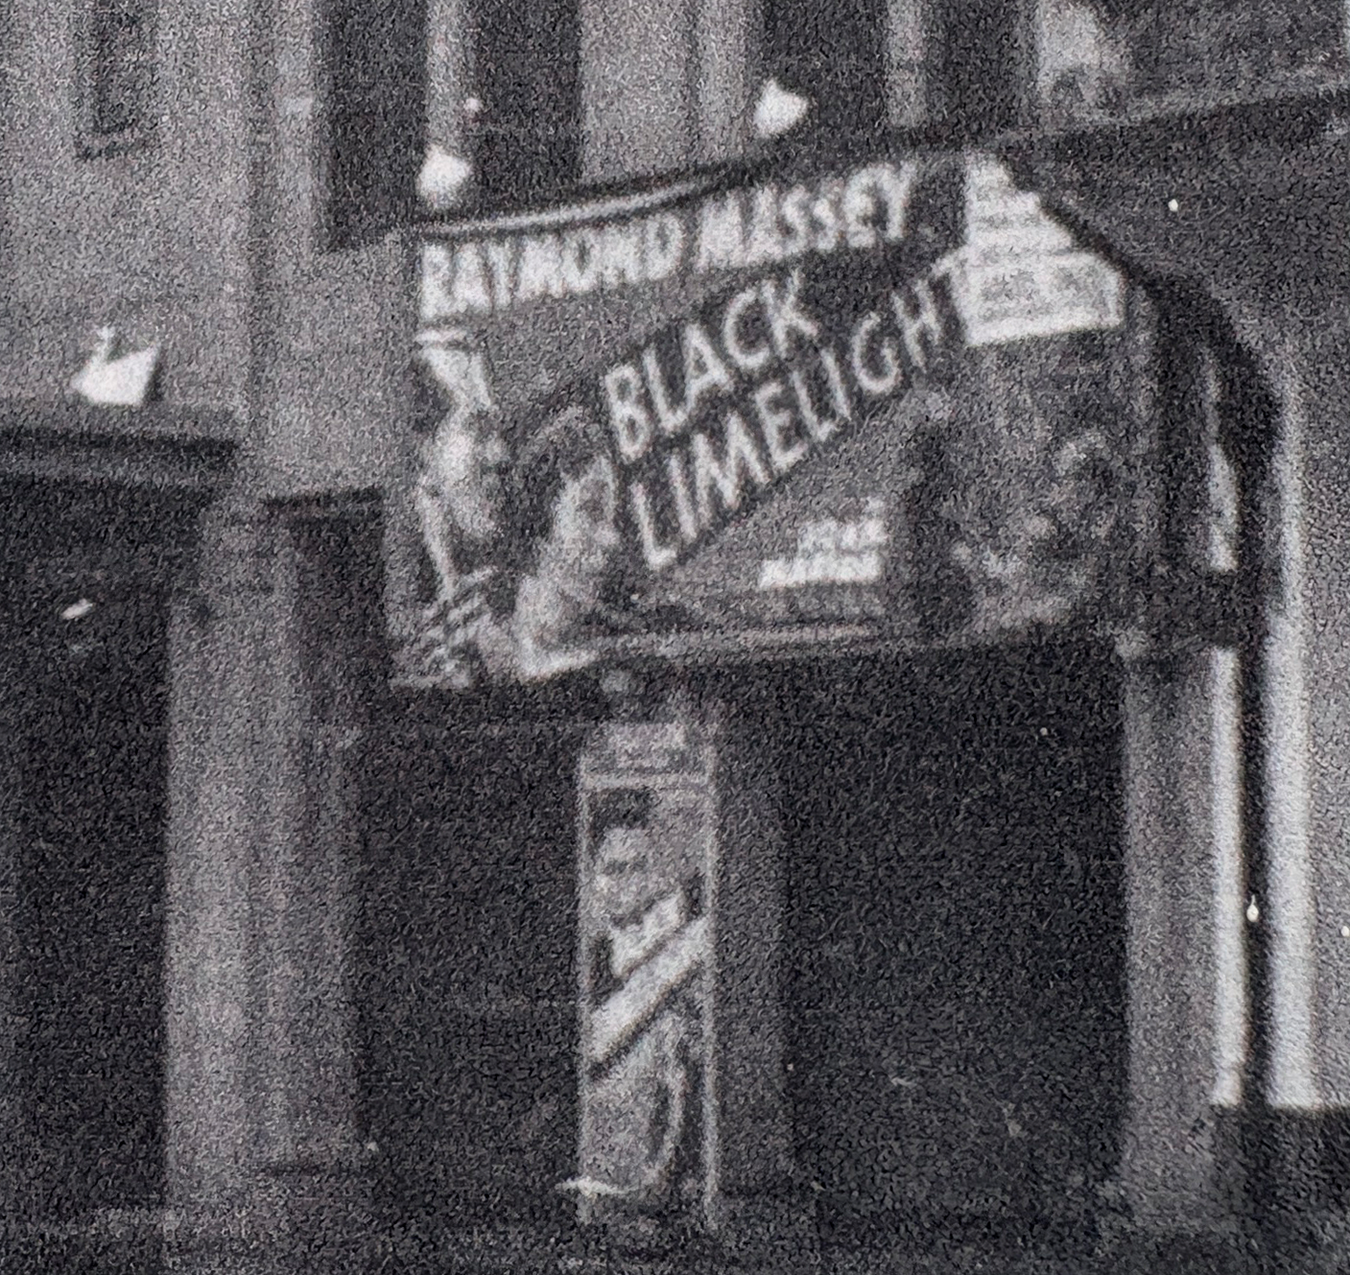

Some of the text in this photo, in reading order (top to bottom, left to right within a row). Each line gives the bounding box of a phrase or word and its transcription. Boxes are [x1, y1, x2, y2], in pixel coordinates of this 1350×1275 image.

[419, 211, 684, 319] RAYMOND
[696, 159, 918, 269] MASSEY
[602, 269, 820, 463] BLACK
